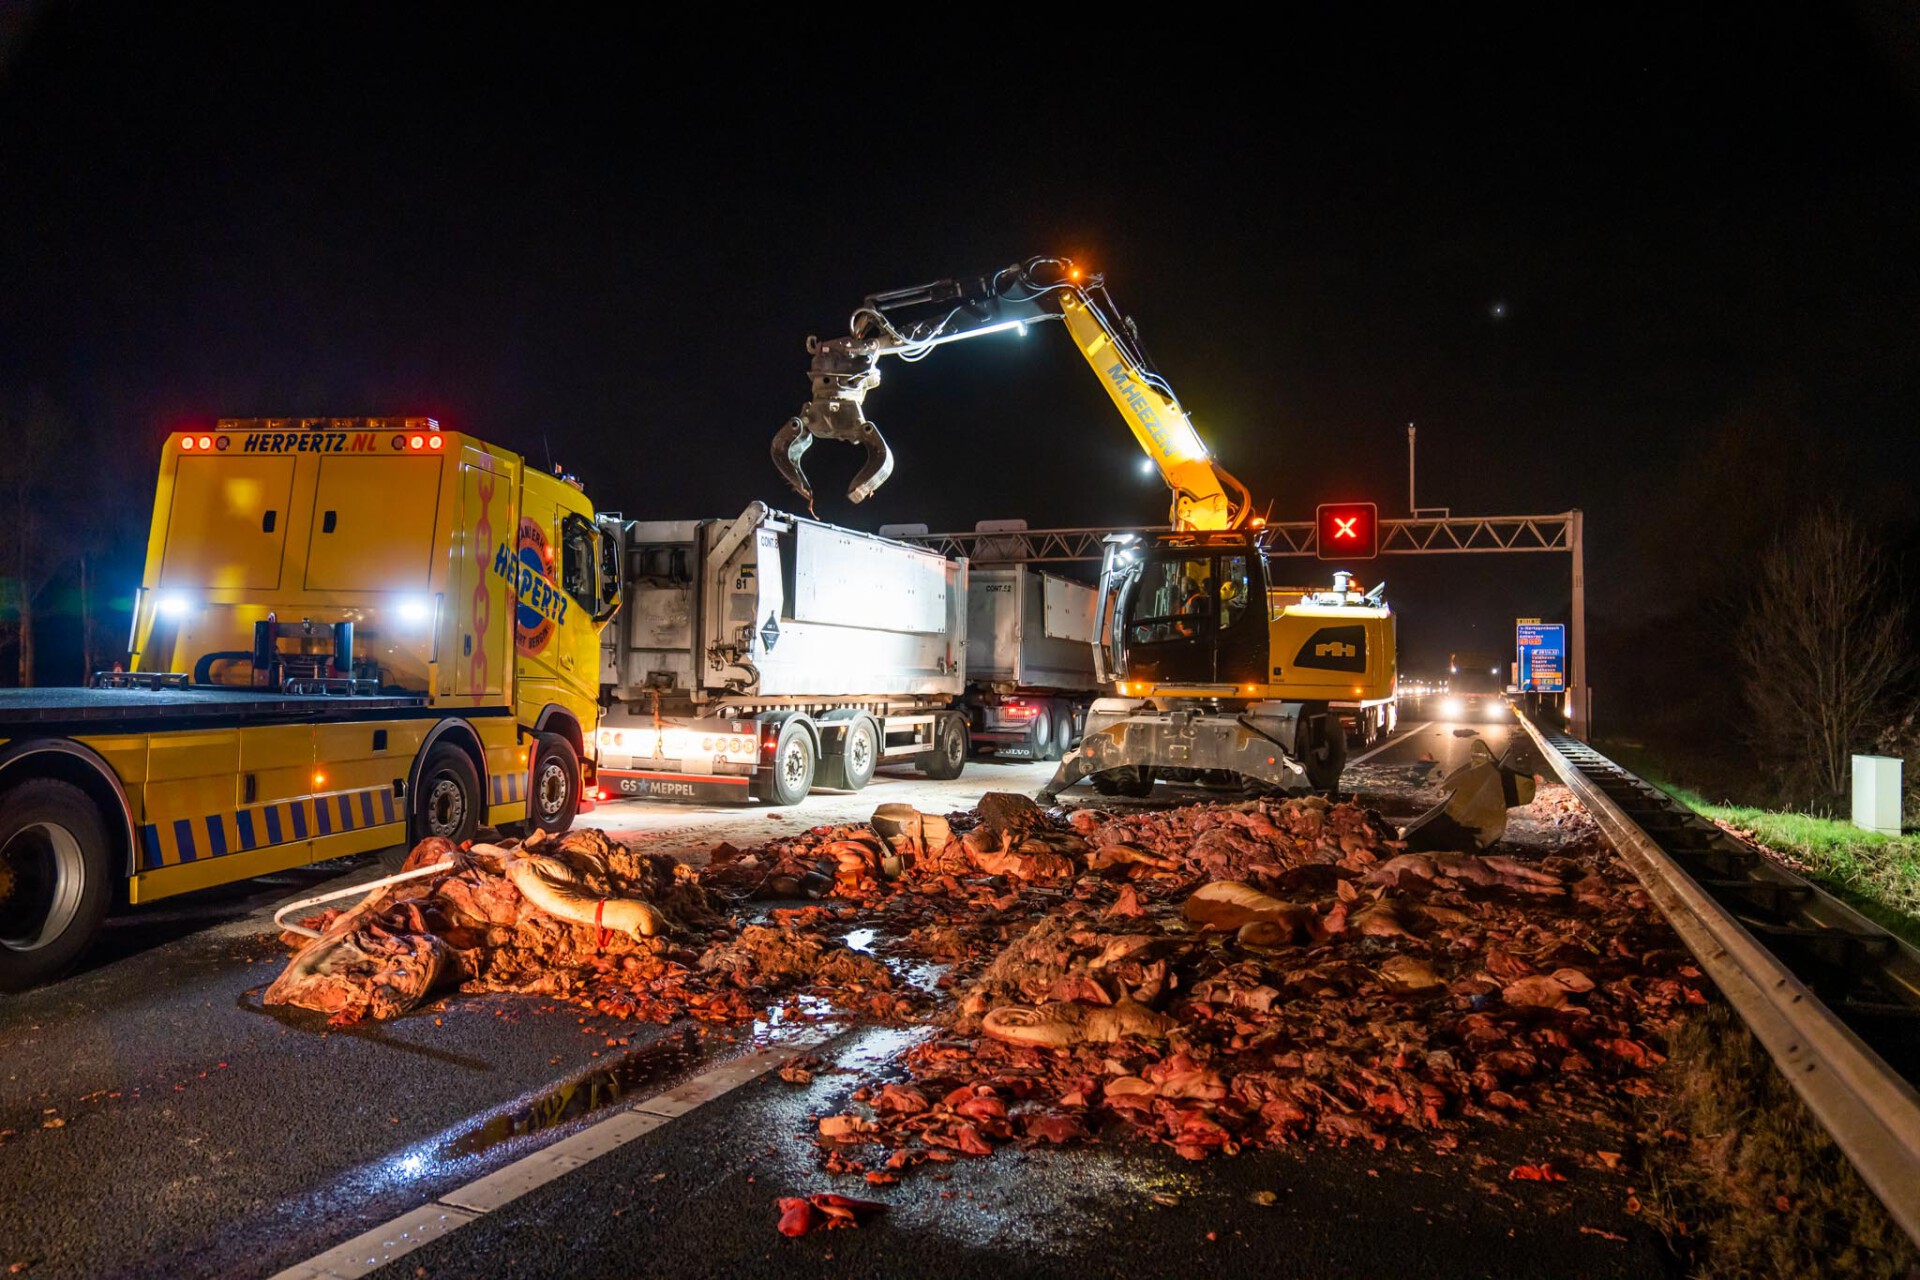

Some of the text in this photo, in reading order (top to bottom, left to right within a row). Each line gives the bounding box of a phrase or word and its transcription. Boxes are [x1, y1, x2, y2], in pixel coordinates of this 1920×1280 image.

[244, 433, 376, 453] HERPERTZ.NL
[736, 578, 748, 590] 81
[620, 779, 696, 796] GS MEPPEL
